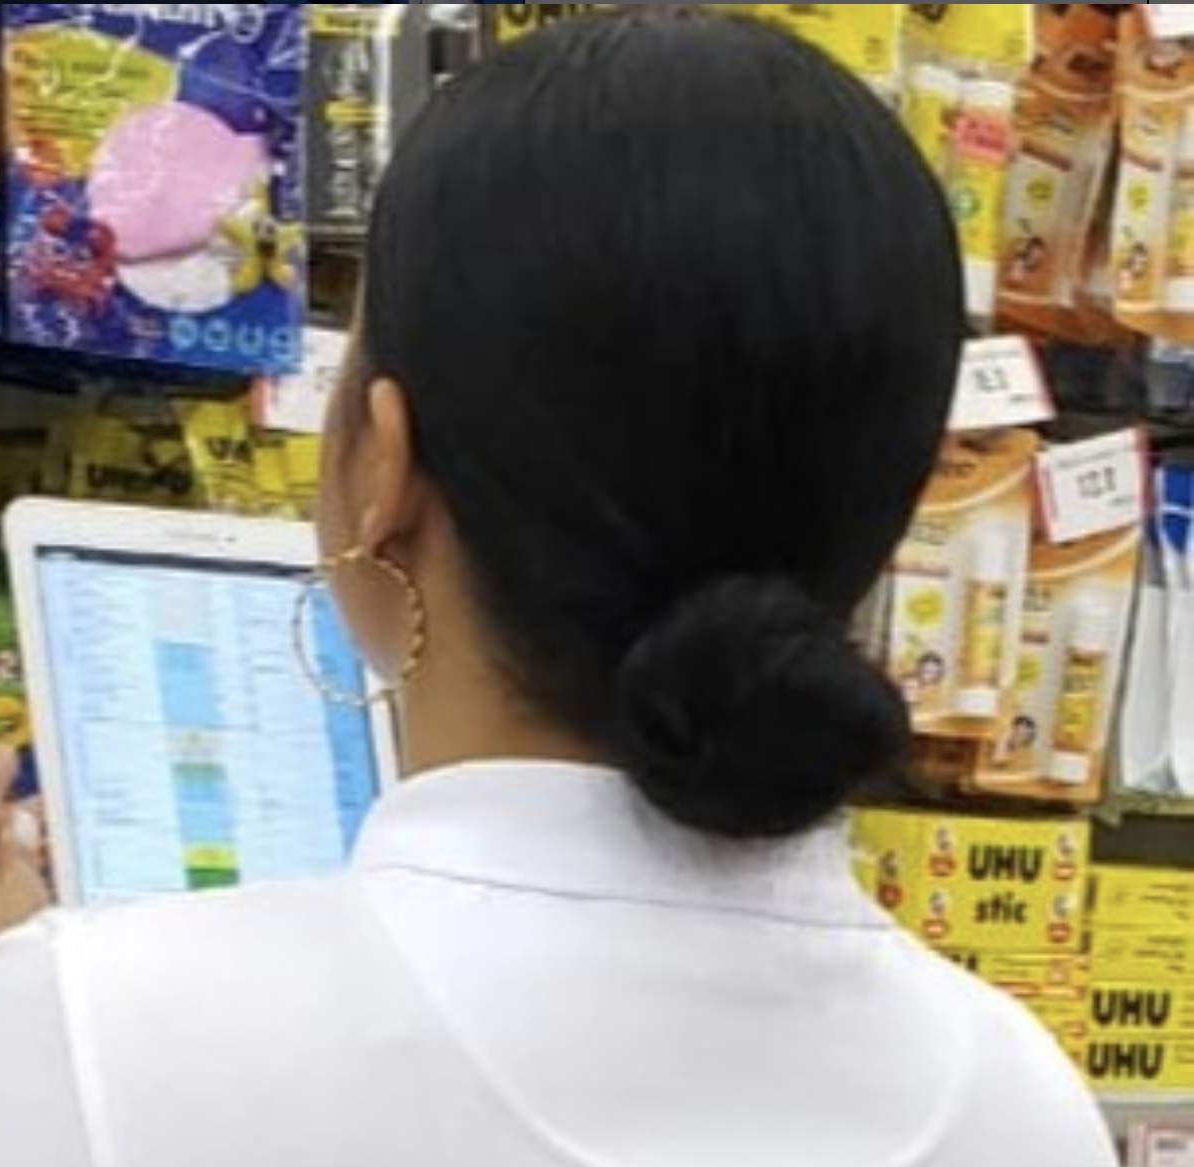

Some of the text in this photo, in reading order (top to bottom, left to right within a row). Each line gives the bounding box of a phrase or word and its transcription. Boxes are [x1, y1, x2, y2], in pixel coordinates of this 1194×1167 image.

[967, 844, 1043, 883] UHU
[974, 891, 1028, 924] stic
[1092, 988, 1171, 1027] UHU
[1087, 1043, 1164, 1080] UHU
